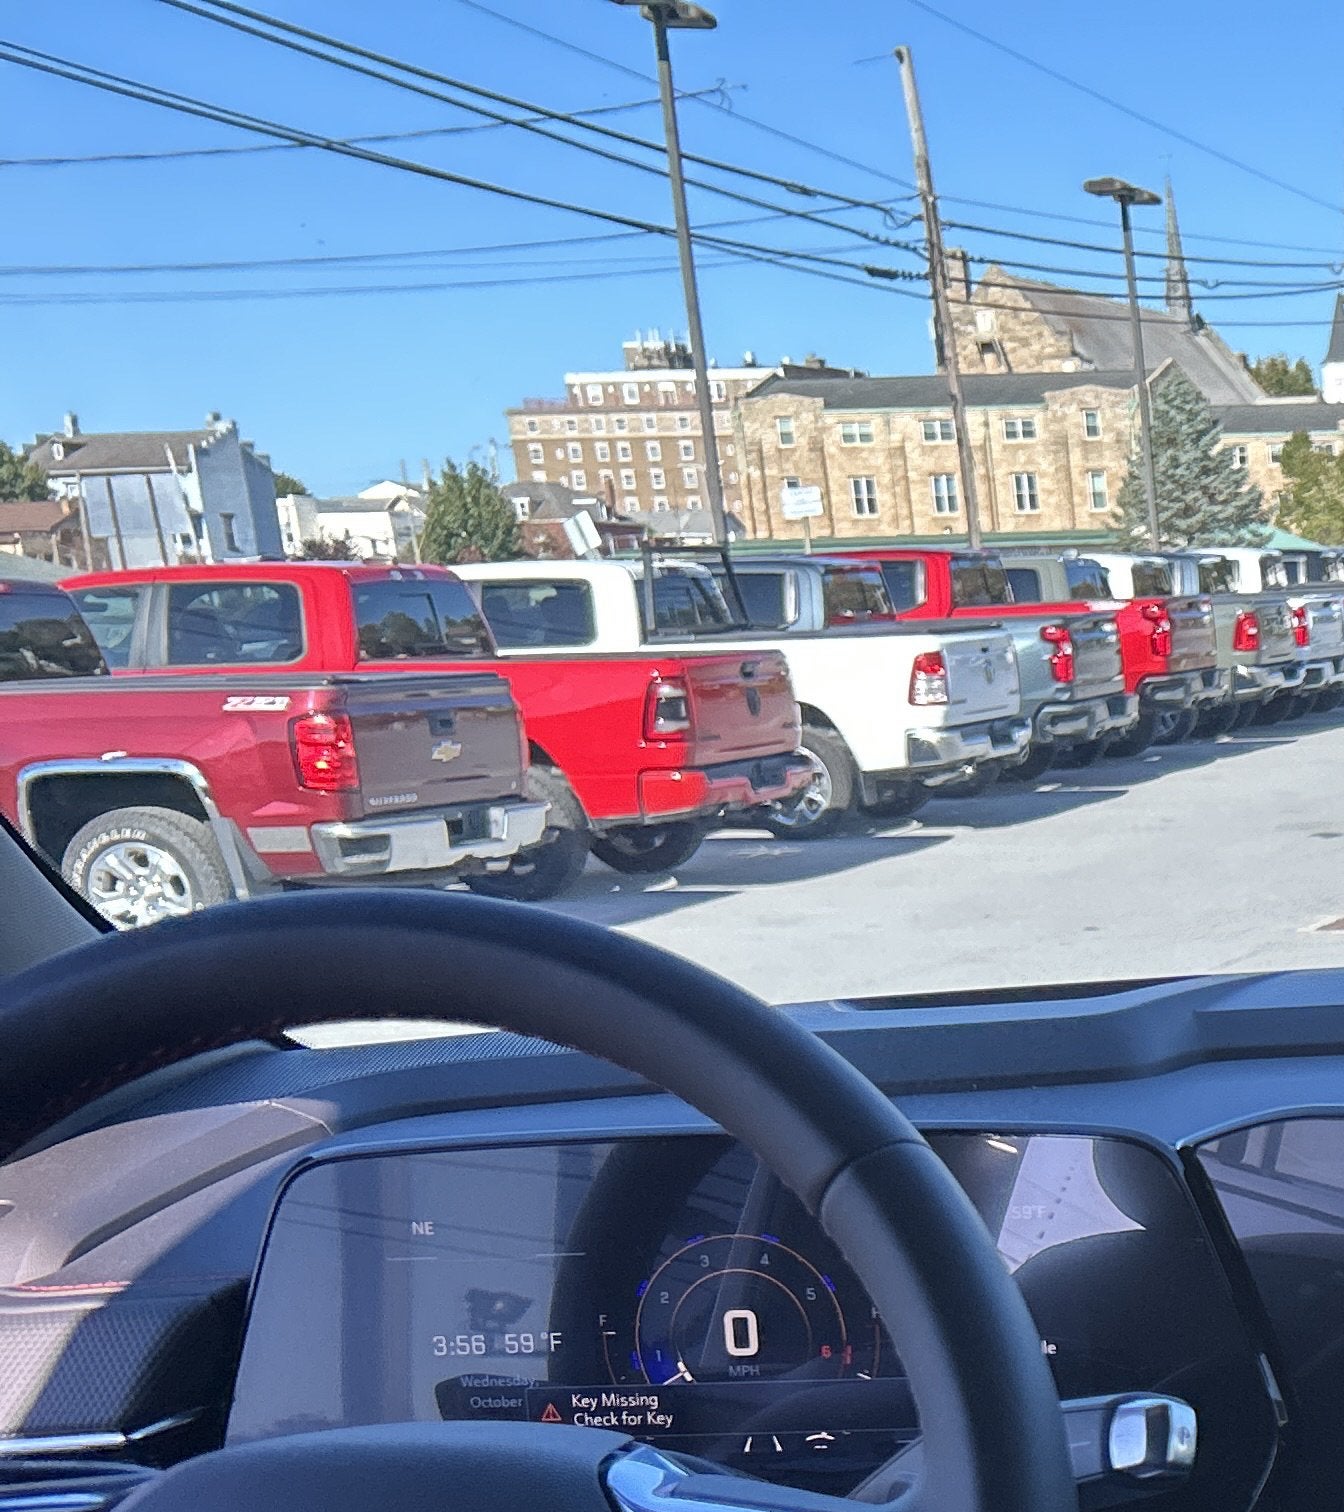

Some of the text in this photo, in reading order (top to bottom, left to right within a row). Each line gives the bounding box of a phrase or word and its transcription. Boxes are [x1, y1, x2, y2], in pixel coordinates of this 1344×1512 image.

[411, 1221, 435, 1235] NE
[700, 1255, 710, 1267] 3
[760, 1253, 770, 1265] 4
[660, 1292, 669, 1304] 2
[806, 1288, 817, 1300] 5
[723, 1309, 759, 1357] 0
[433, 1334, 486, 1356] 3:56
[504, 1333, 535, 1354] 59
[728, 1365, 760, 1377] MPH
[470, 1396, 523, 1409] October
[571, 1393, 659, 1411] Key Missing
[574, 1411, 673, 1428] Check for Key
